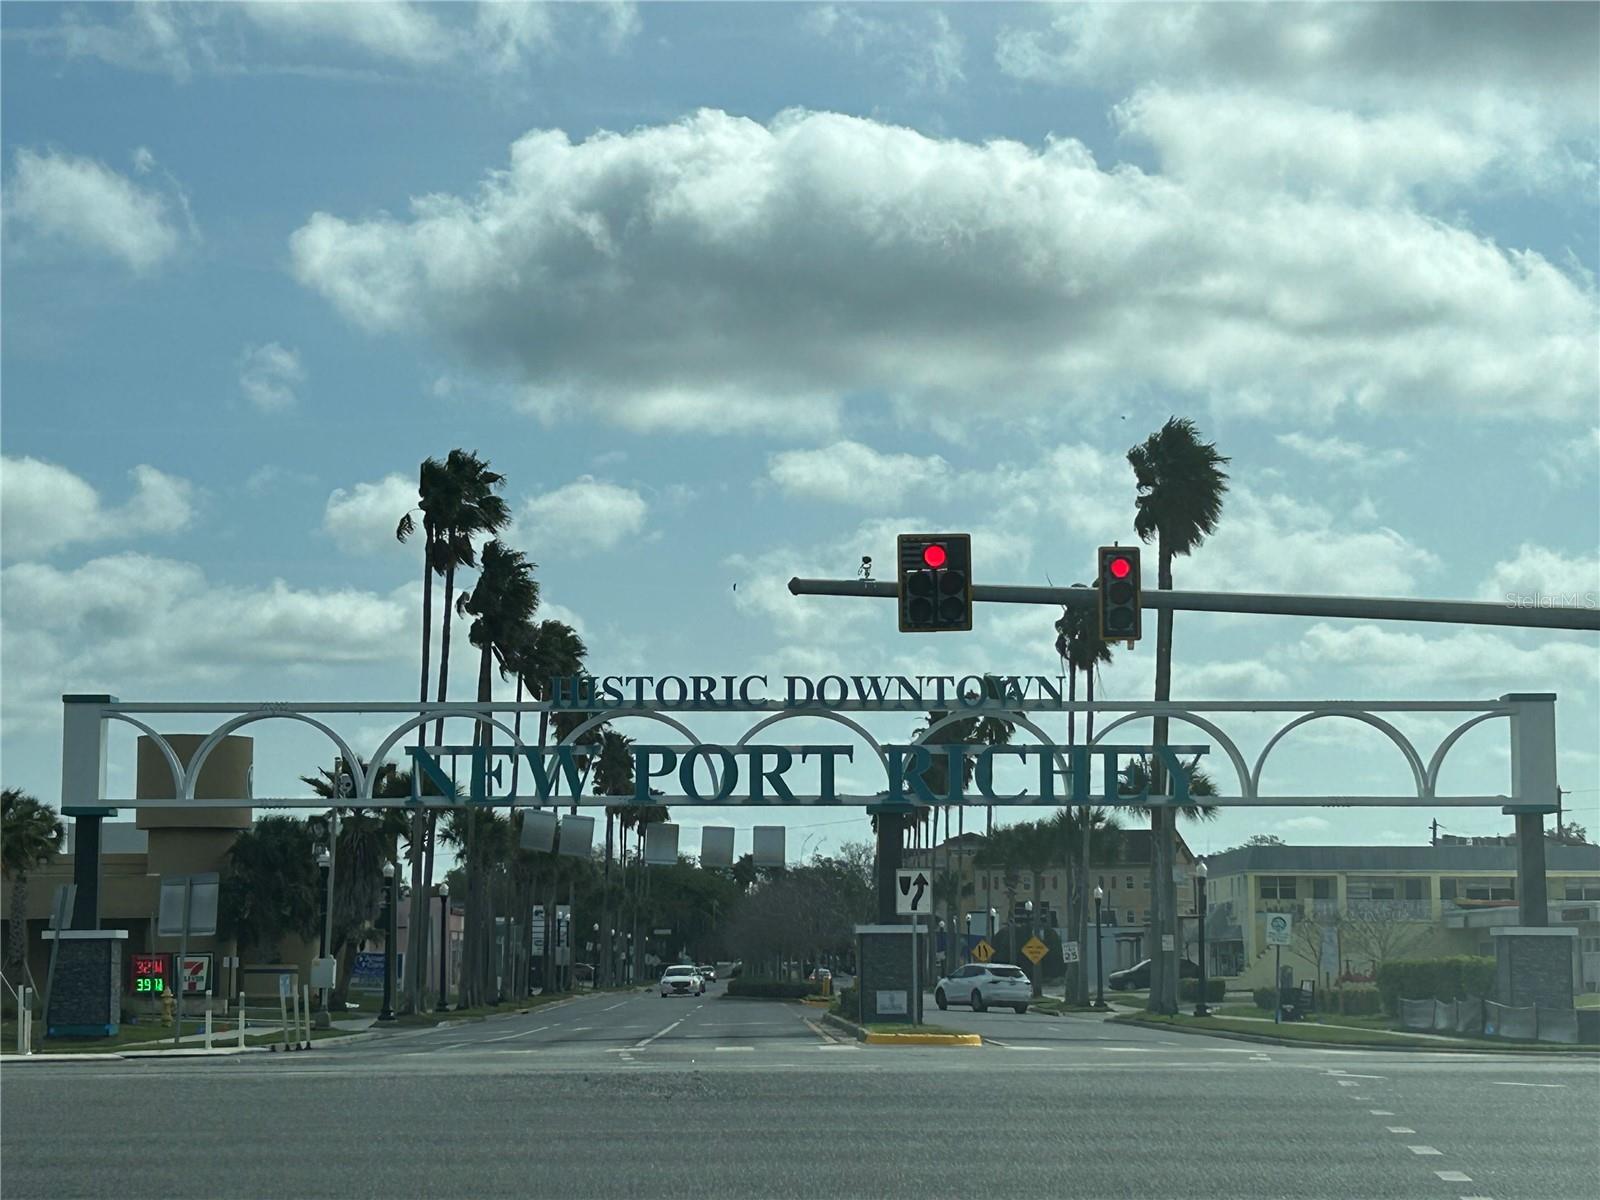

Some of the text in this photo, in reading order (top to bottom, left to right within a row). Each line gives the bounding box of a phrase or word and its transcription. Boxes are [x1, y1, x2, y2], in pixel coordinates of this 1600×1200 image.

[551, 675, 1066, 709] HISTORIC DOWNTOWN
[404, 744, 1210, 804] NEW PORT RICHEY
